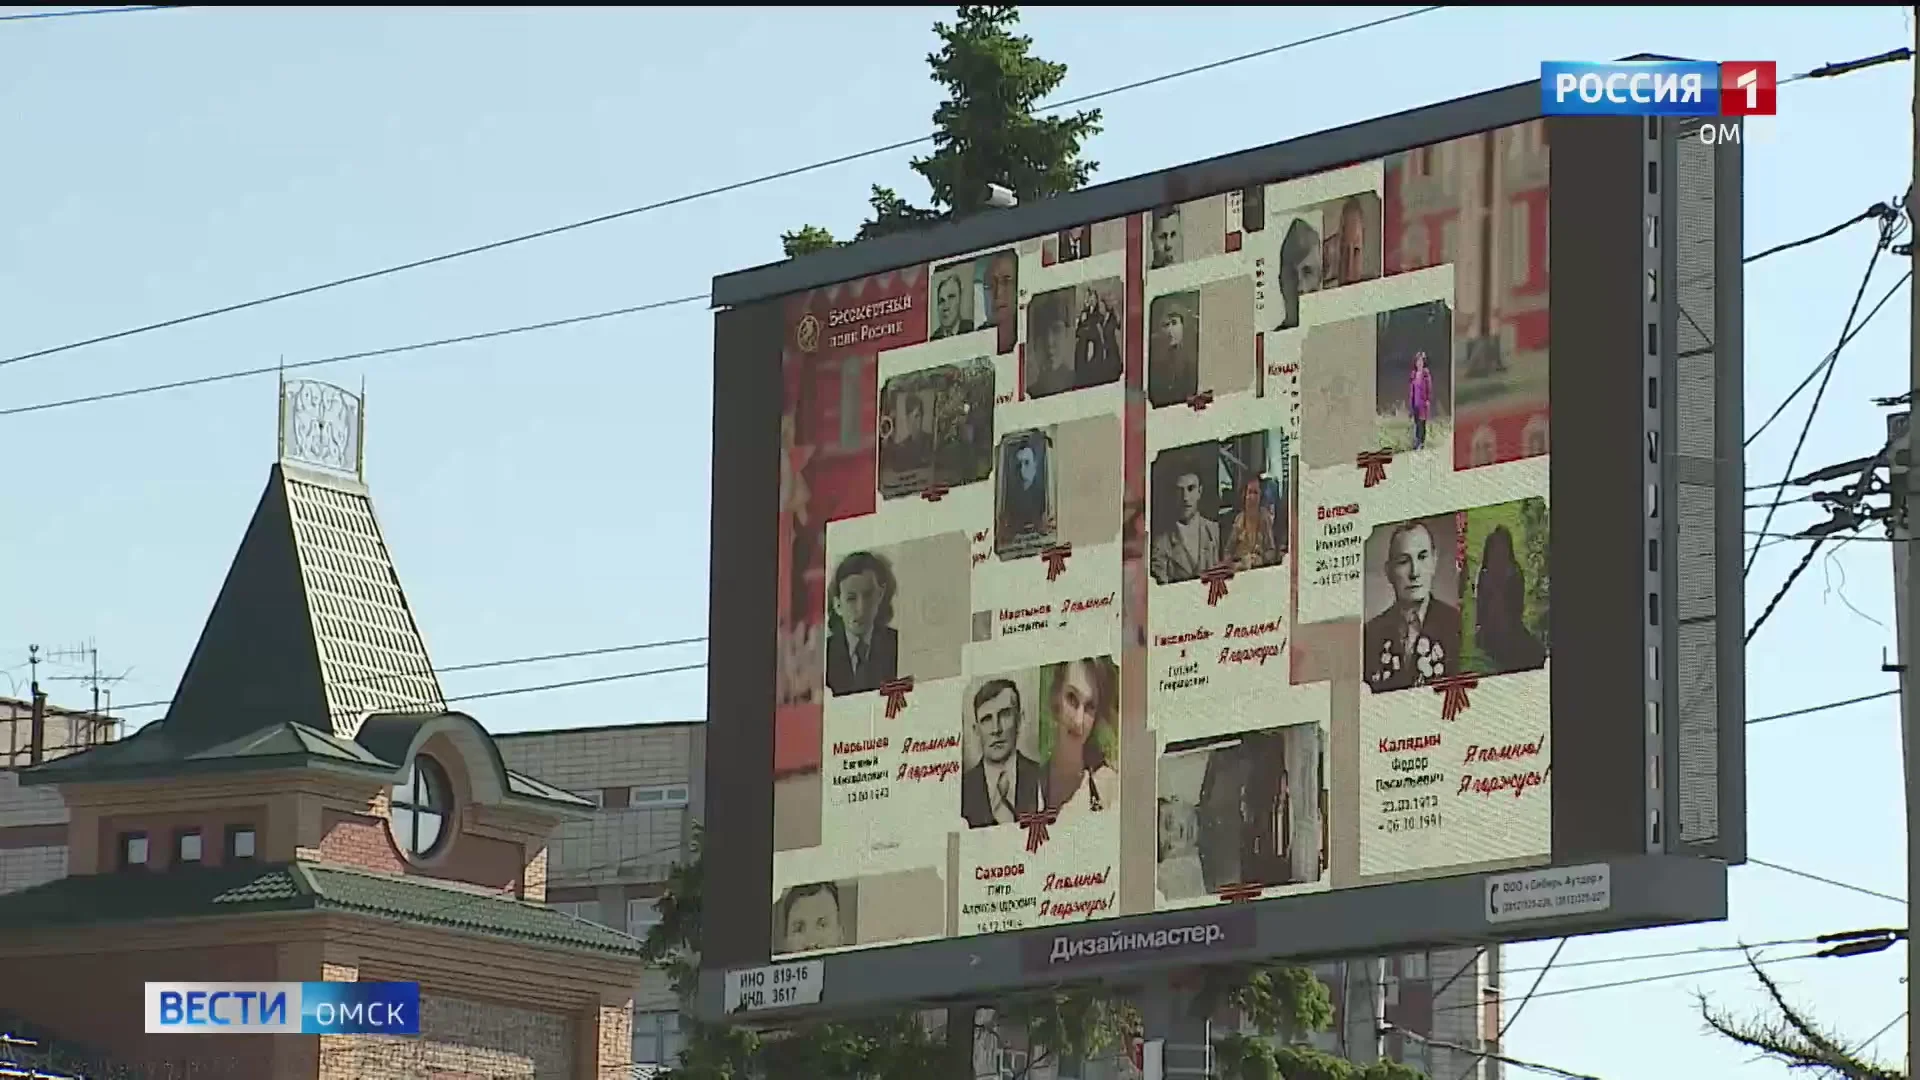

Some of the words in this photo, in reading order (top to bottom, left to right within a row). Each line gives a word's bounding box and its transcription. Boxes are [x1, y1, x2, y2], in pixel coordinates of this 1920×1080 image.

[1379, 734, 1442, 754] Калядин
[975, 862, 1025, 880] Сахаров
[1049, 923, 1226, 965] Дизайнмастер.
[740, 971, 765, 988] ИНО
[773, 965, 808, 985] 819-16
[772, 986, 797, 1004] 3617
